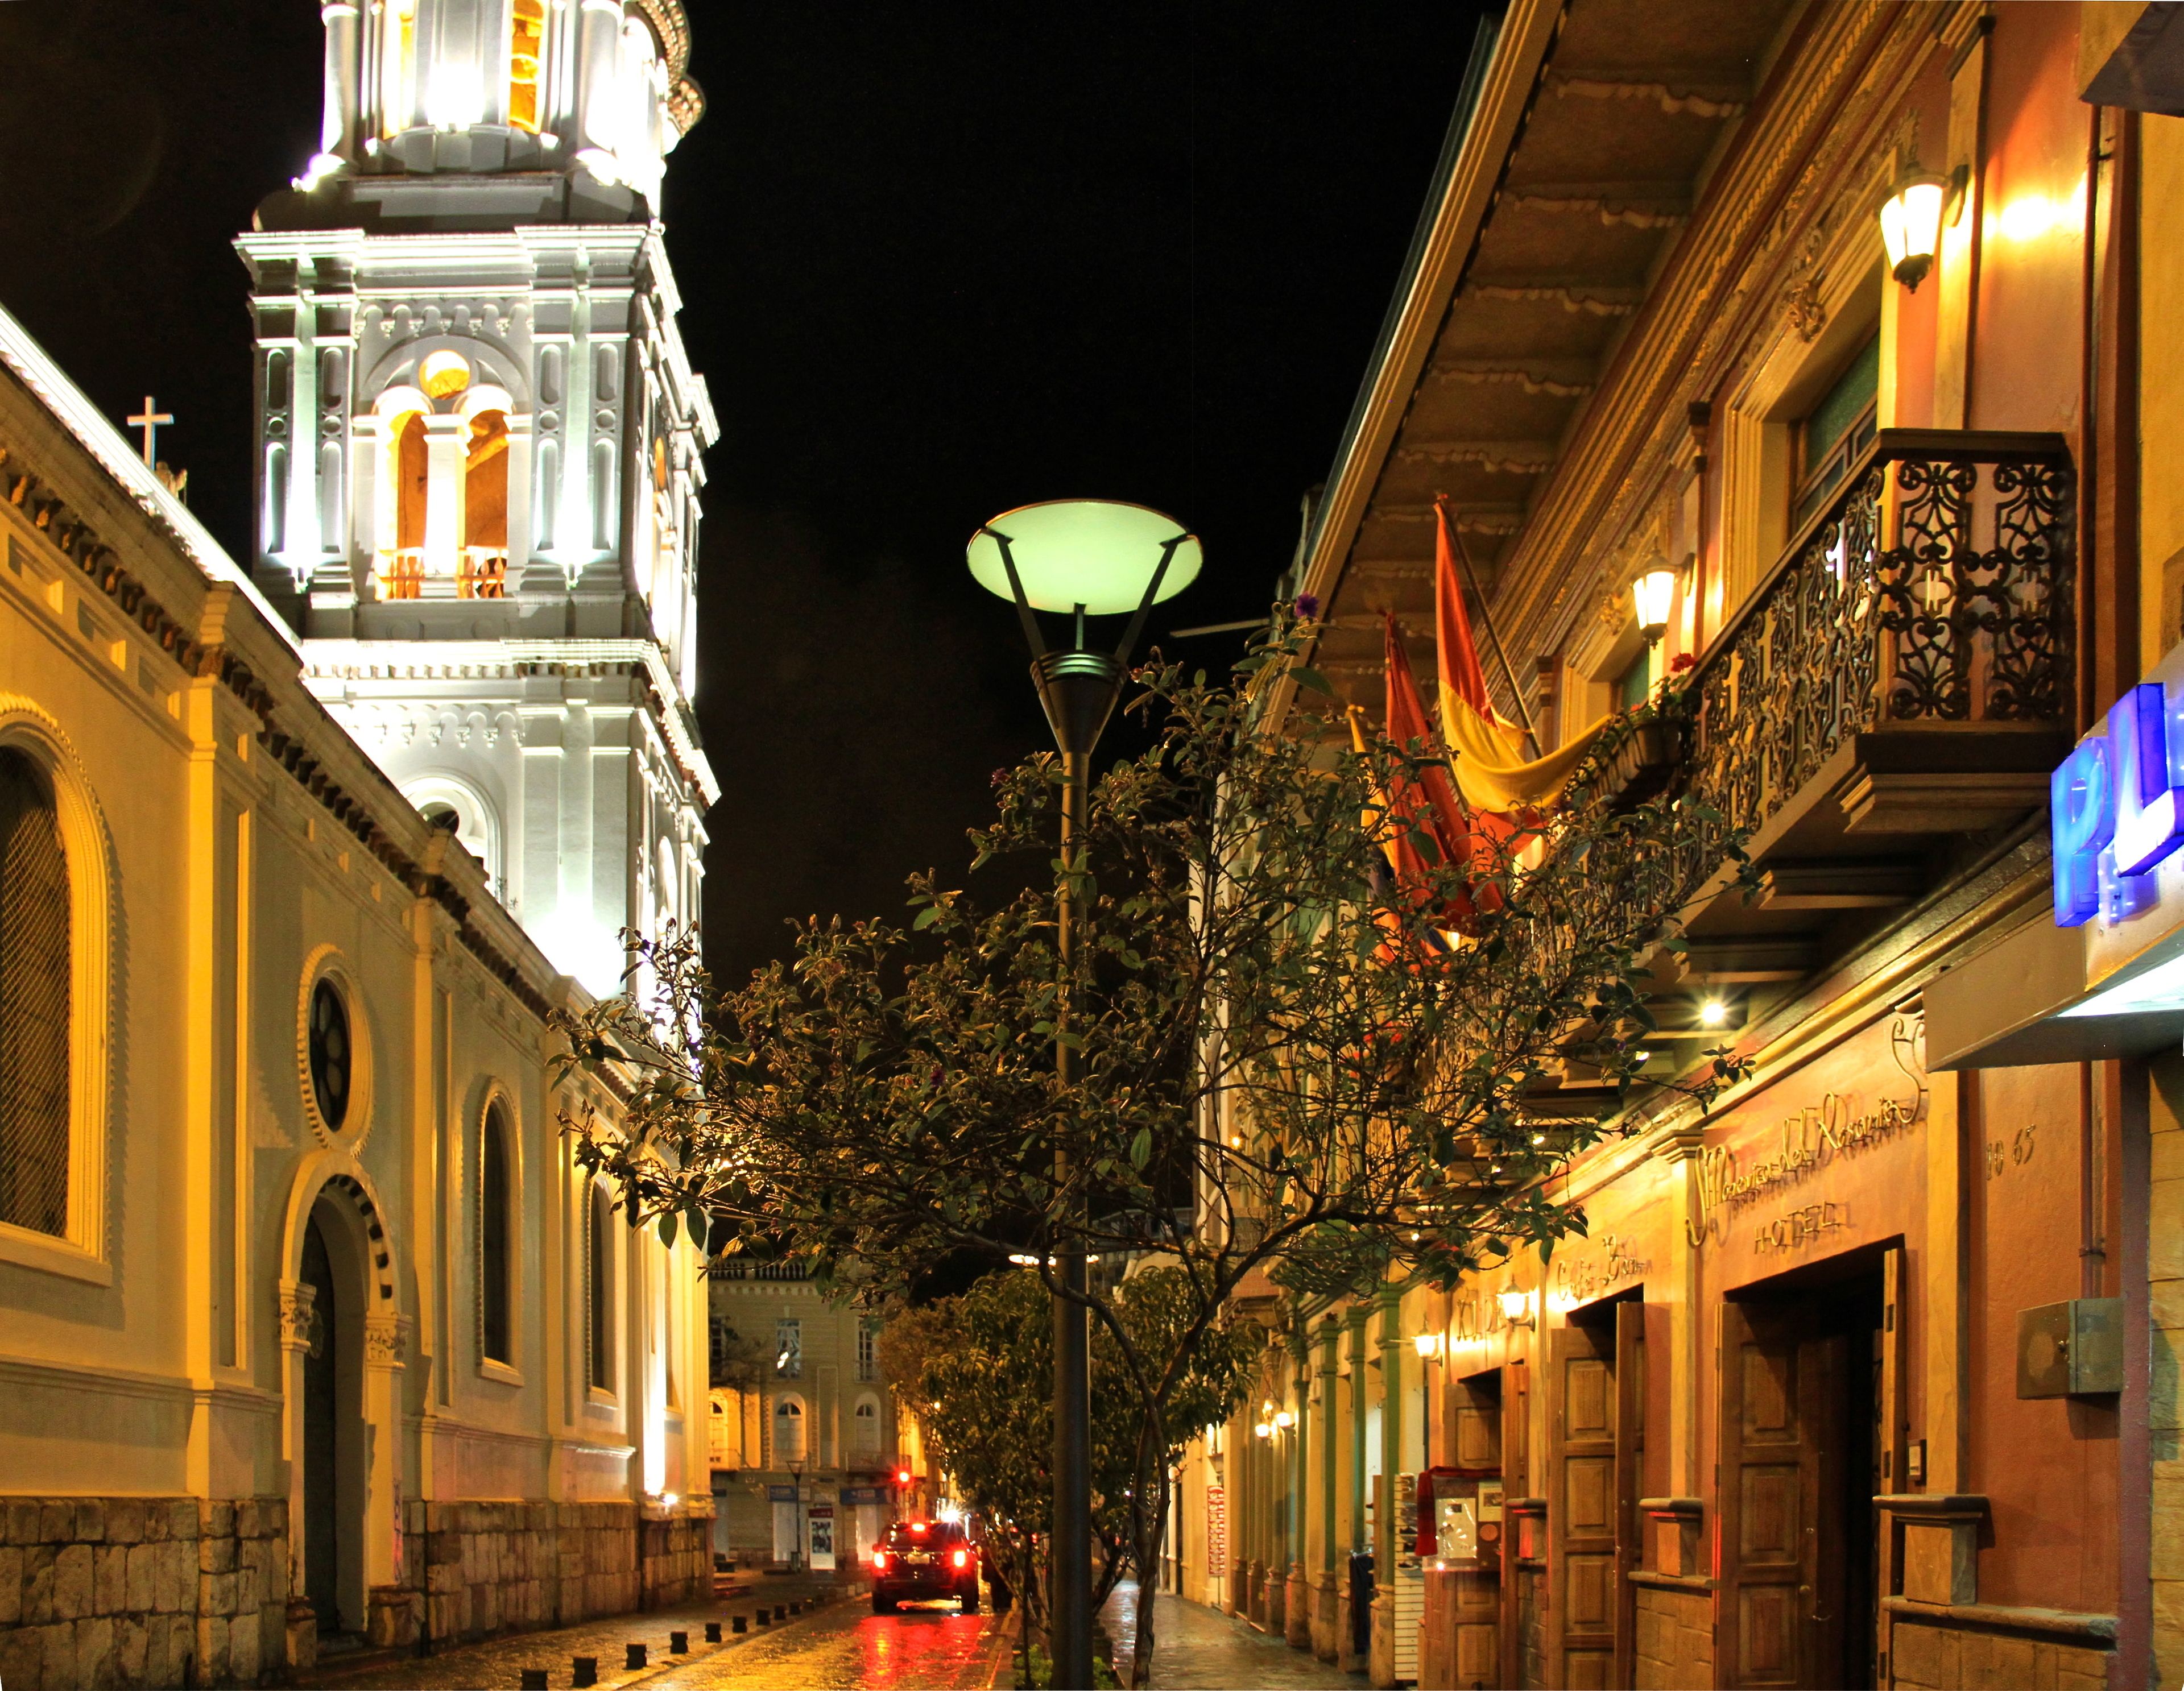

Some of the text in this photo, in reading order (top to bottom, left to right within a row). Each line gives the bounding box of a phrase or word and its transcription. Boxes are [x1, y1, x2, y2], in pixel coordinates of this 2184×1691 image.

[1780, 1107, 1807, 1172] del
[2012, 1124, 2037, 1166] 65
[1753, 1200, 1833, 1254] HOTEL
